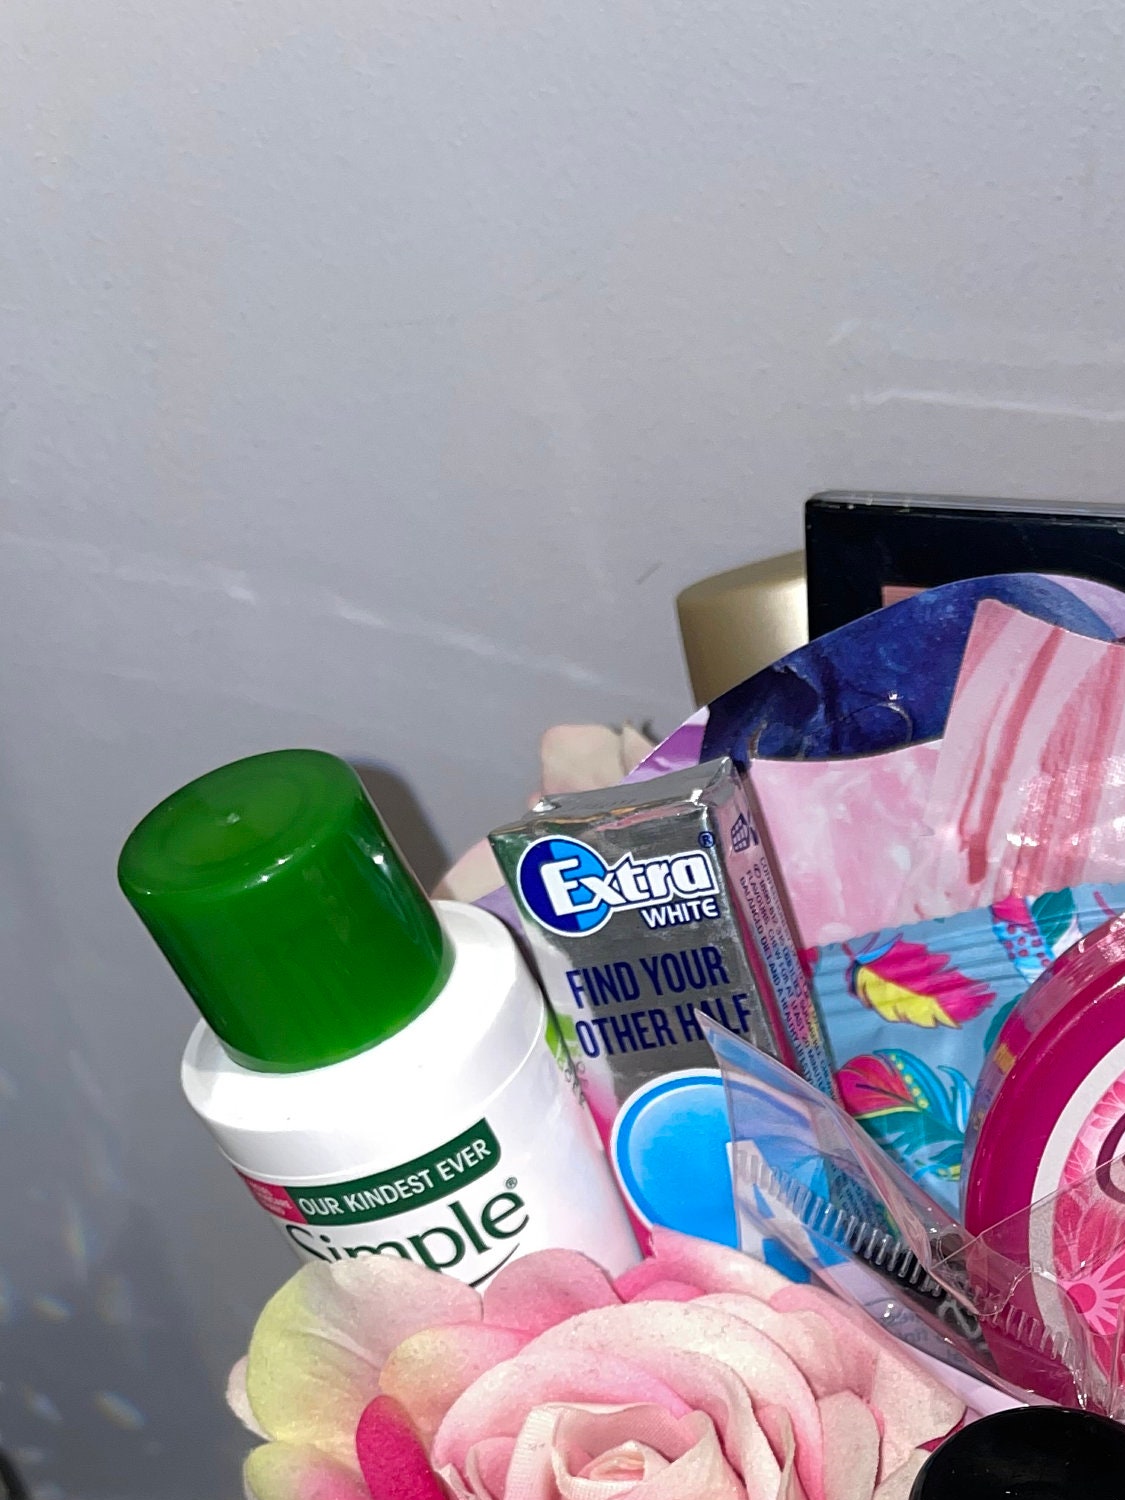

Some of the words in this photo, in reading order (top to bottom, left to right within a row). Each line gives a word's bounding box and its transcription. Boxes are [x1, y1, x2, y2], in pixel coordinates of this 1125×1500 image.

[539, 852, 719, 917] Extra
[640, 897, 720, 930] WHITE
[565, 961, 641, 1010] FIND
[639, 945, 731, 997] YOUR
[575, 1008, 676, 1059] OTHER
[674, 992, 752, 1042] HALF
[297, 1196, 345, 1216] OUR
[343, 1168, 435, 1214] KINDEST
[435, 1138, 492, 1182] EVER
